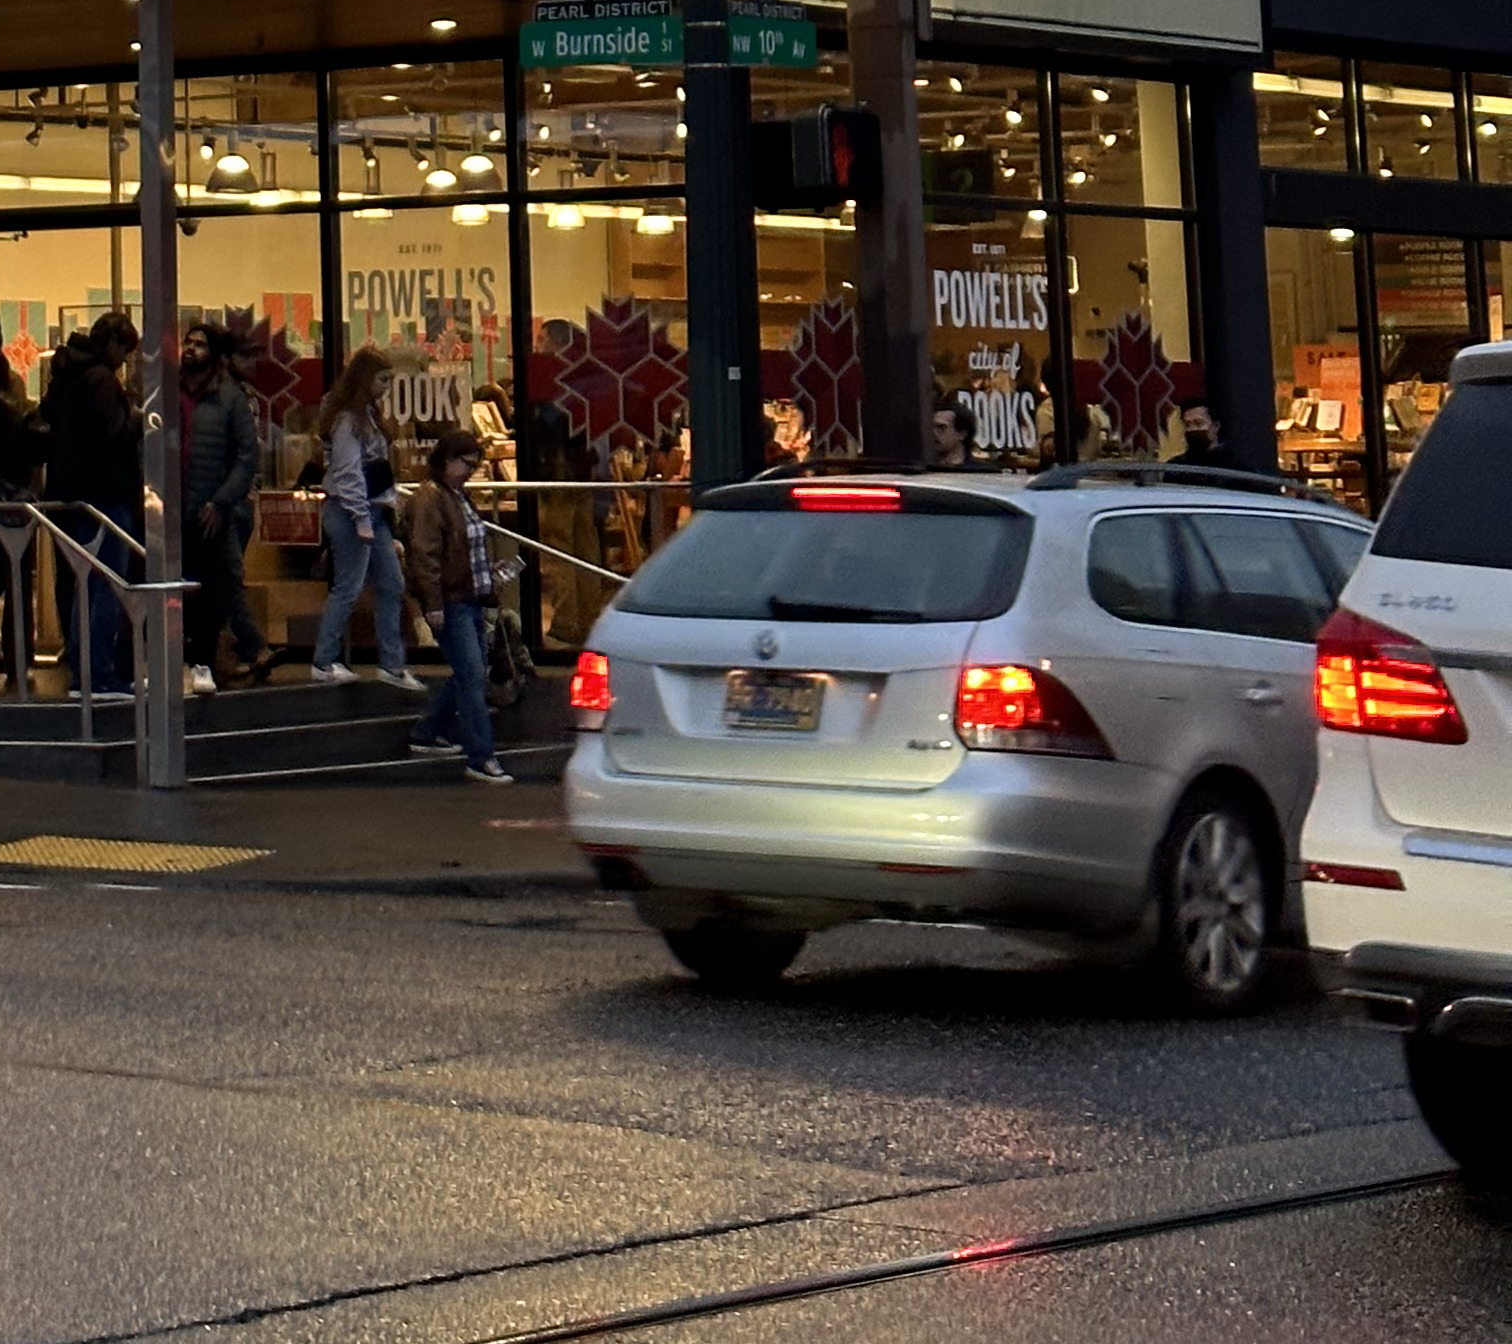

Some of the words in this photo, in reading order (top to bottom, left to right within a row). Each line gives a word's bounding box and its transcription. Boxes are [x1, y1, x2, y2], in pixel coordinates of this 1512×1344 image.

[538, 5, 589, 21] PEARL
[595, 1, 668, 17] DISTRICT
[532, 40, 545, 57] W
[556, 26, 650, 56] Burnside
[661, 38, 673, 52] St
[732, 35, 751, 53] NW
[792, 40, 806, 59] Av
[348, 266, 496, 318] POWELL'S
[933, 269, 1048, 331] POWELL'S
[968, 341, 998, 378] city
[1002, 342, 1021, 380] of
